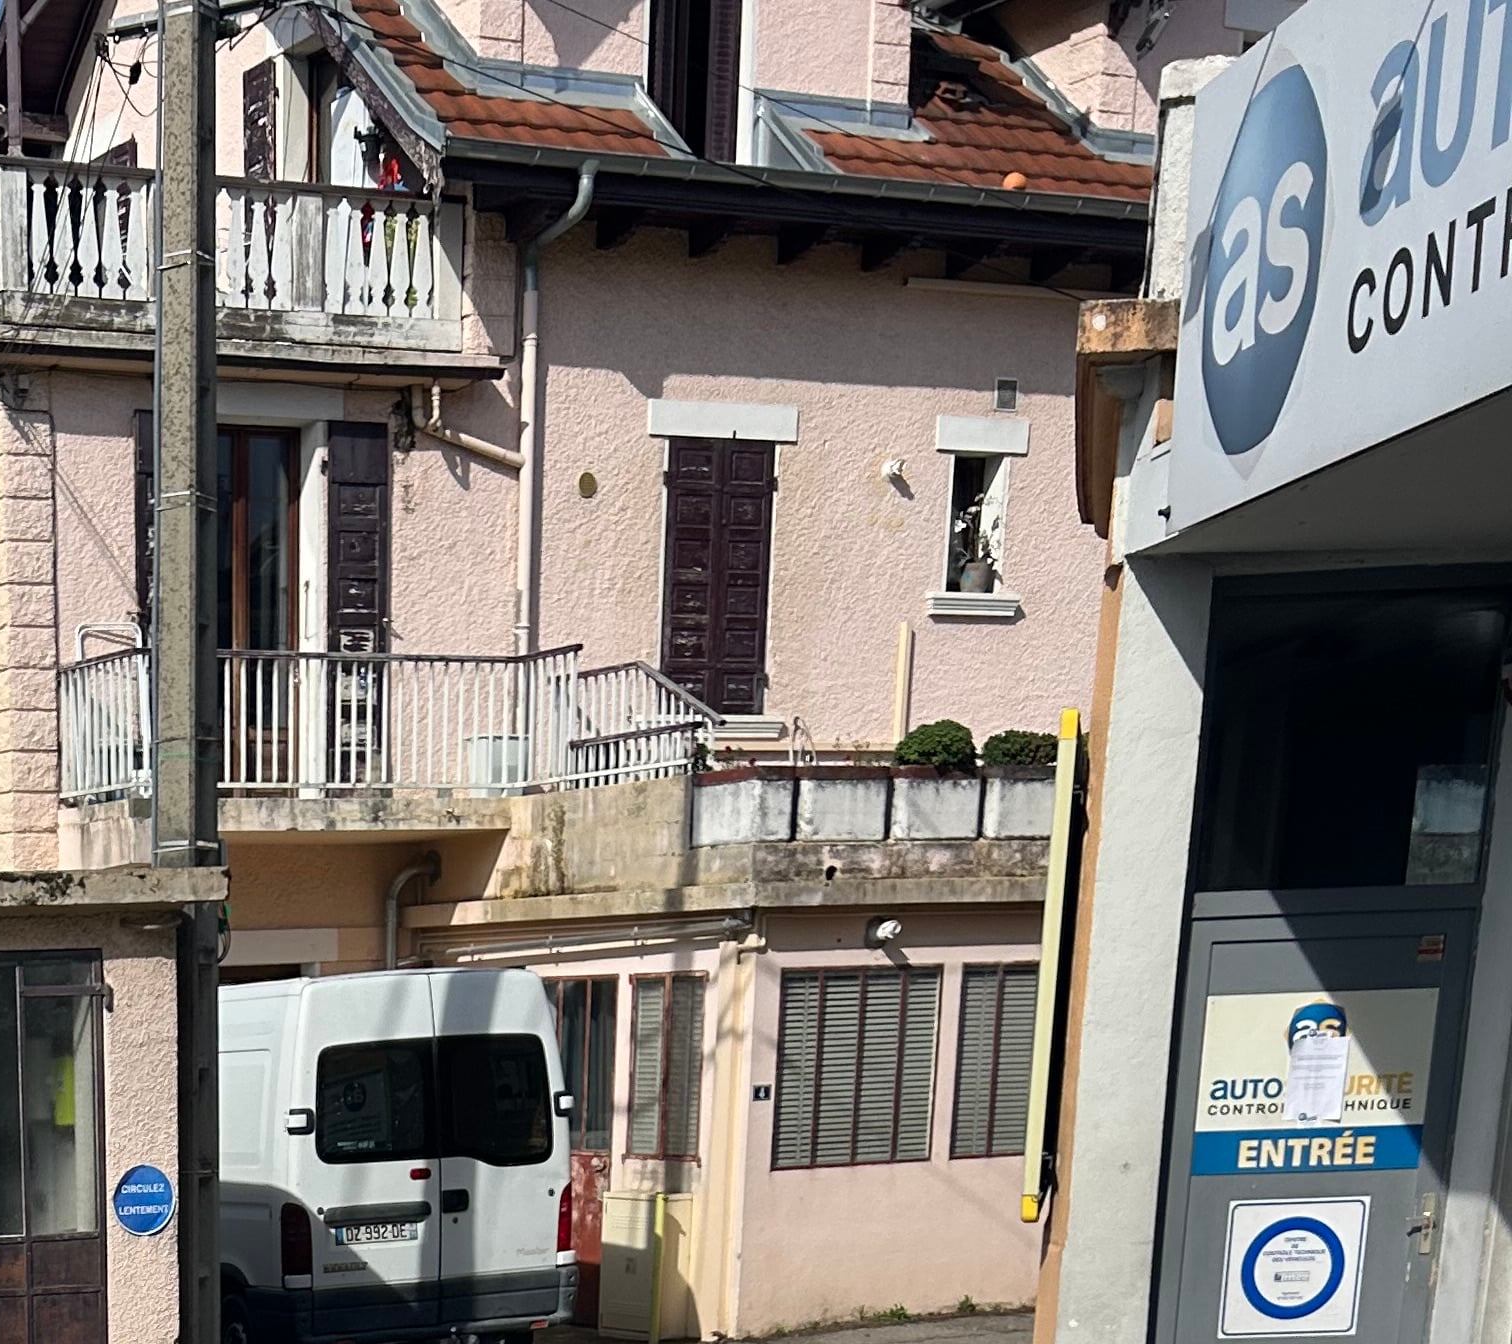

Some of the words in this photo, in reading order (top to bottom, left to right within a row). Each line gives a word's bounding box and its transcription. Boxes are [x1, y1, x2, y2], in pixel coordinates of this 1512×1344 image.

[1211, 161, 1315, 367] as
[1347, 187, 1512, 354] CONT
[1344, 1097, 1412, 1112] HNIQUE
[1237, 1129, 1377, 1169] ENTRÉE
[121, 1183, 165, 1194] CIRCULEZ
[118, 1204, 169, 1216] LENTEMENT
